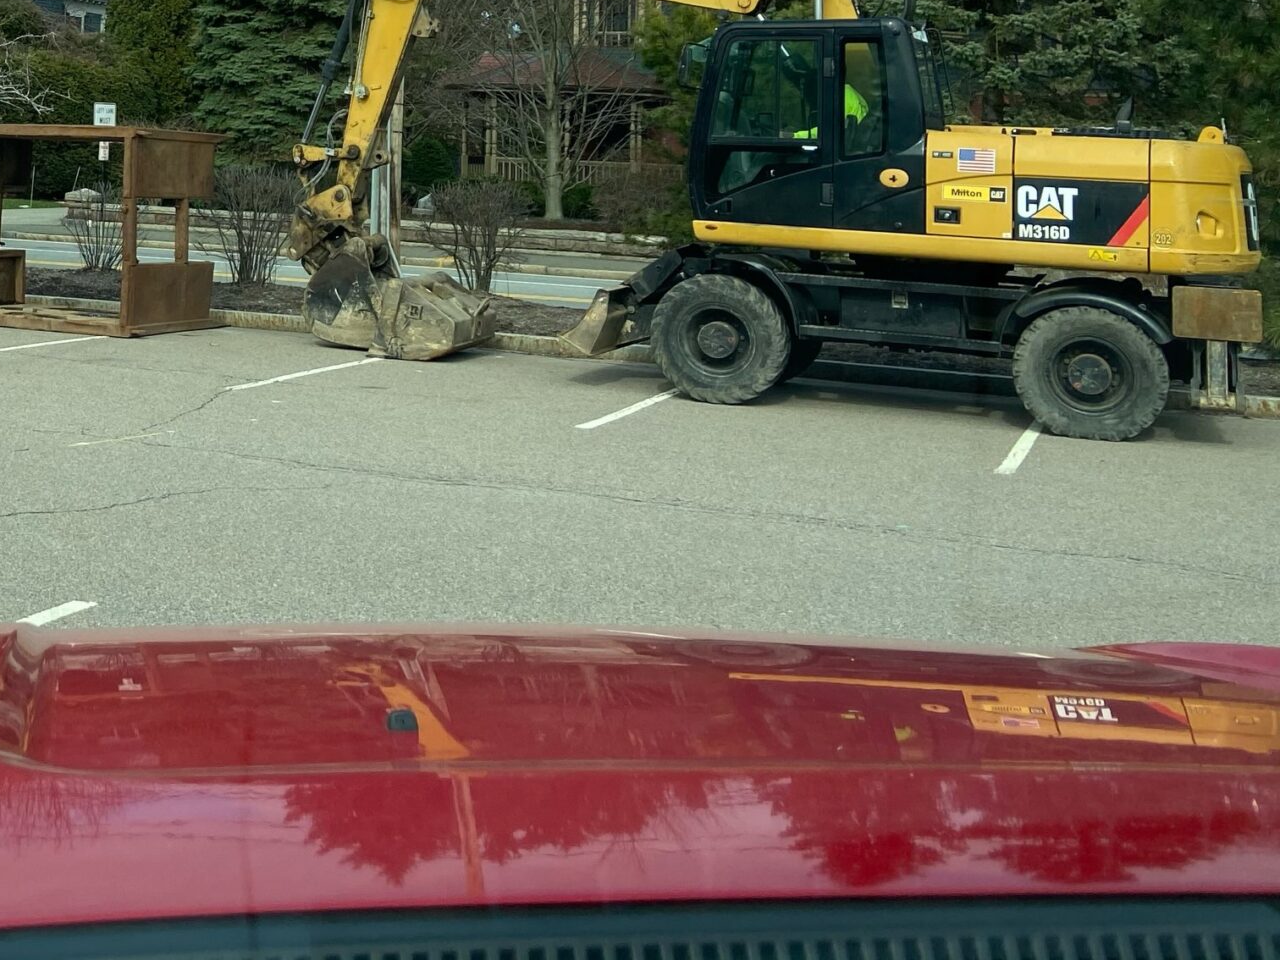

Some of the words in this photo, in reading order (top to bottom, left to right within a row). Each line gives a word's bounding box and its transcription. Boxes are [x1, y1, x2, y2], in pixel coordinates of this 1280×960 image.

[951, 187, 982, 198] Milton
[990, 189, 1005, 200] CAT
[1017, 185, 1079, 221] CAT
[1019, 224, 1070, 240] M316D
[1155, 233, 1171, 245] 202
